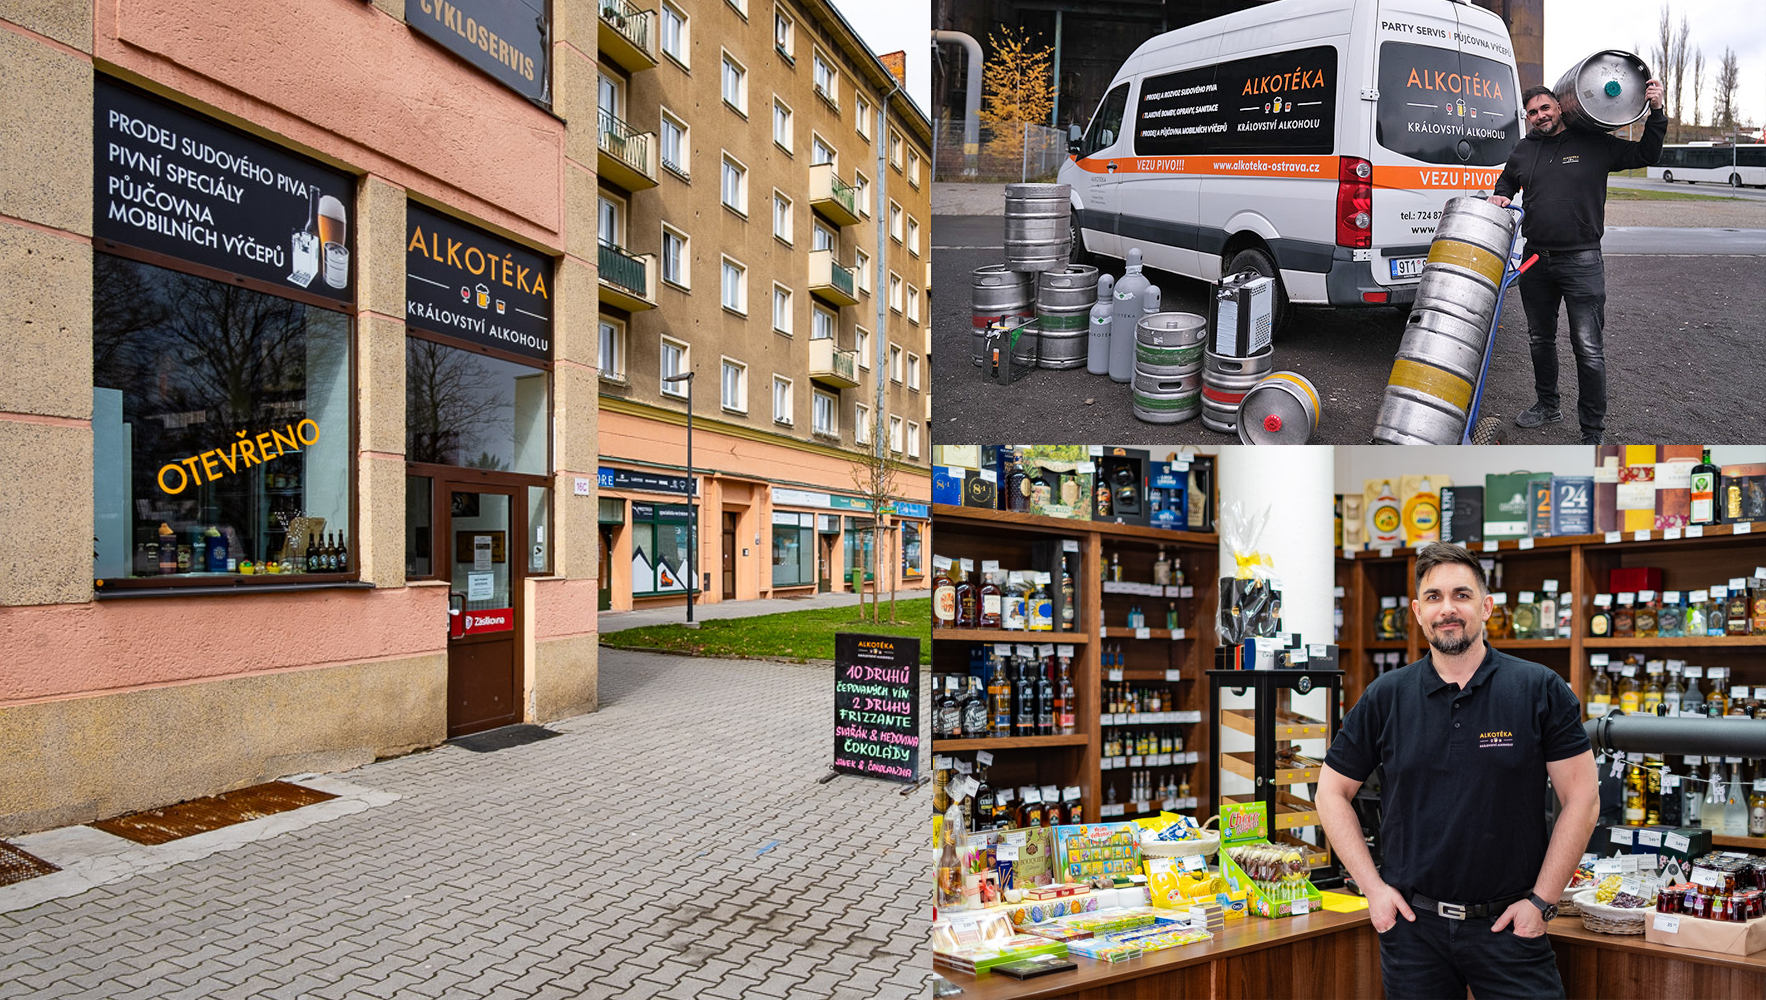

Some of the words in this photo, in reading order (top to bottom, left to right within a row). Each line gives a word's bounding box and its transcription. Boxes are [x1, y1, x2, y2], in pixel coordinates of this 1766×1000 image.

[1381, 21, 1414, 33] PARTY
[1416, 26, 1446, 39] SERVIS
[1454, 31, 1490, 49] PŮJČOVNA
[1490, 42, 1512, 58] VÝČEPŮ
[1242, 67, 1324, 96] ALKOTÉKA
[1407, 67, 1503, 100] ALKOTÉKA
[1145, 93, 1161, 101] PRODEJ
[1165, 89, 1181, 98] ROZVOZ
[1181, 85, 1206, 96] SUDOVÉHO
[1205, 84, 1217, 92] PIVA
[1144, 109, 1161, 119] TLAKOVÉ
[1176, 106, 1195, 115] OPRAVY,
[1195, 104, 1219, 113] SANITACE
[1142, 130, 1157, 138] PRODEJ
[1160, 126, 1181, 137] PŮJČOVNA
[1182, 125, 1207, 135] MOBILNÍCH
[1207, 122, 1228, 133] VÝČEPŮ
[1237, 118, 1278, 132] KRÁLOVSTVÍ
[1278, 118, 1320, 131] ALKOHOLU
[1408, 120, 1464, 135] KRÁLOVSTVÍ
[1466, 127, 1505, 140] ALKOHOLU
[109, 110, 176, 151] PRODEJ
[181, 137, 274, 185] SUDOVÉHO
[277, 173, 308, 200] PIVA
[109, 142, 162, 177] PIVNÍ
[166, 163, 244, 204] SPECIÁLY
[1136, 159, 1155, 171] VEZU
[1156, 159, 1185, 171] PIVO!!!
[1213, 160, 1320, 173] www.alkoteka-ostrava.cz
[1420, 171, 1458, 186] VEZU
[109, 175, 214, 225] PŮJČOVNA
[1401, 211, 1415, 220] tel.:
[1417, 211, 1431, 220] 724
[108, 200, 218, 249] MOBILNÍCH
[222, 233, 285, 268] VÝČEPŮ
[408, 225, 548, 299] ALKOTÉKA
[1399, 260, 1416, 273] 9T1
[408, 299, 485, 335] KRÁLOVSTVÍ
[489, 323, 548, 351] ALKOHOLU
[157, 418, 320, 495] OTEVŘENO
[1560, 485, 1588, 508] 24
[858, 641, 894, 649] ALKOTÉKA
[846, 665, 862, 679] 10
[864, 665, 910, 684] DRUHŮ
[836, 680, 888, 696] ČEPOVANÝCH
[892, 685, 910, 699] VÍN
[852, 697, 861, 709] 2
[864, 698, 911, 714] DRUHY
[839, 708, 911, 728] FRIZZANTE
[835, 723, 867, 740] SVAŘÁK
[869, 729, 877, 742] &
[1479, 730, 1513, 738] ALKOTÉKA
[844, 738, 910, 761] ČOKOLÁDY
[858, 760, 864, 771] &
[1229, 811, 1260, 829] Choco
[1021, 856, 1045, 866] BOUQUET
